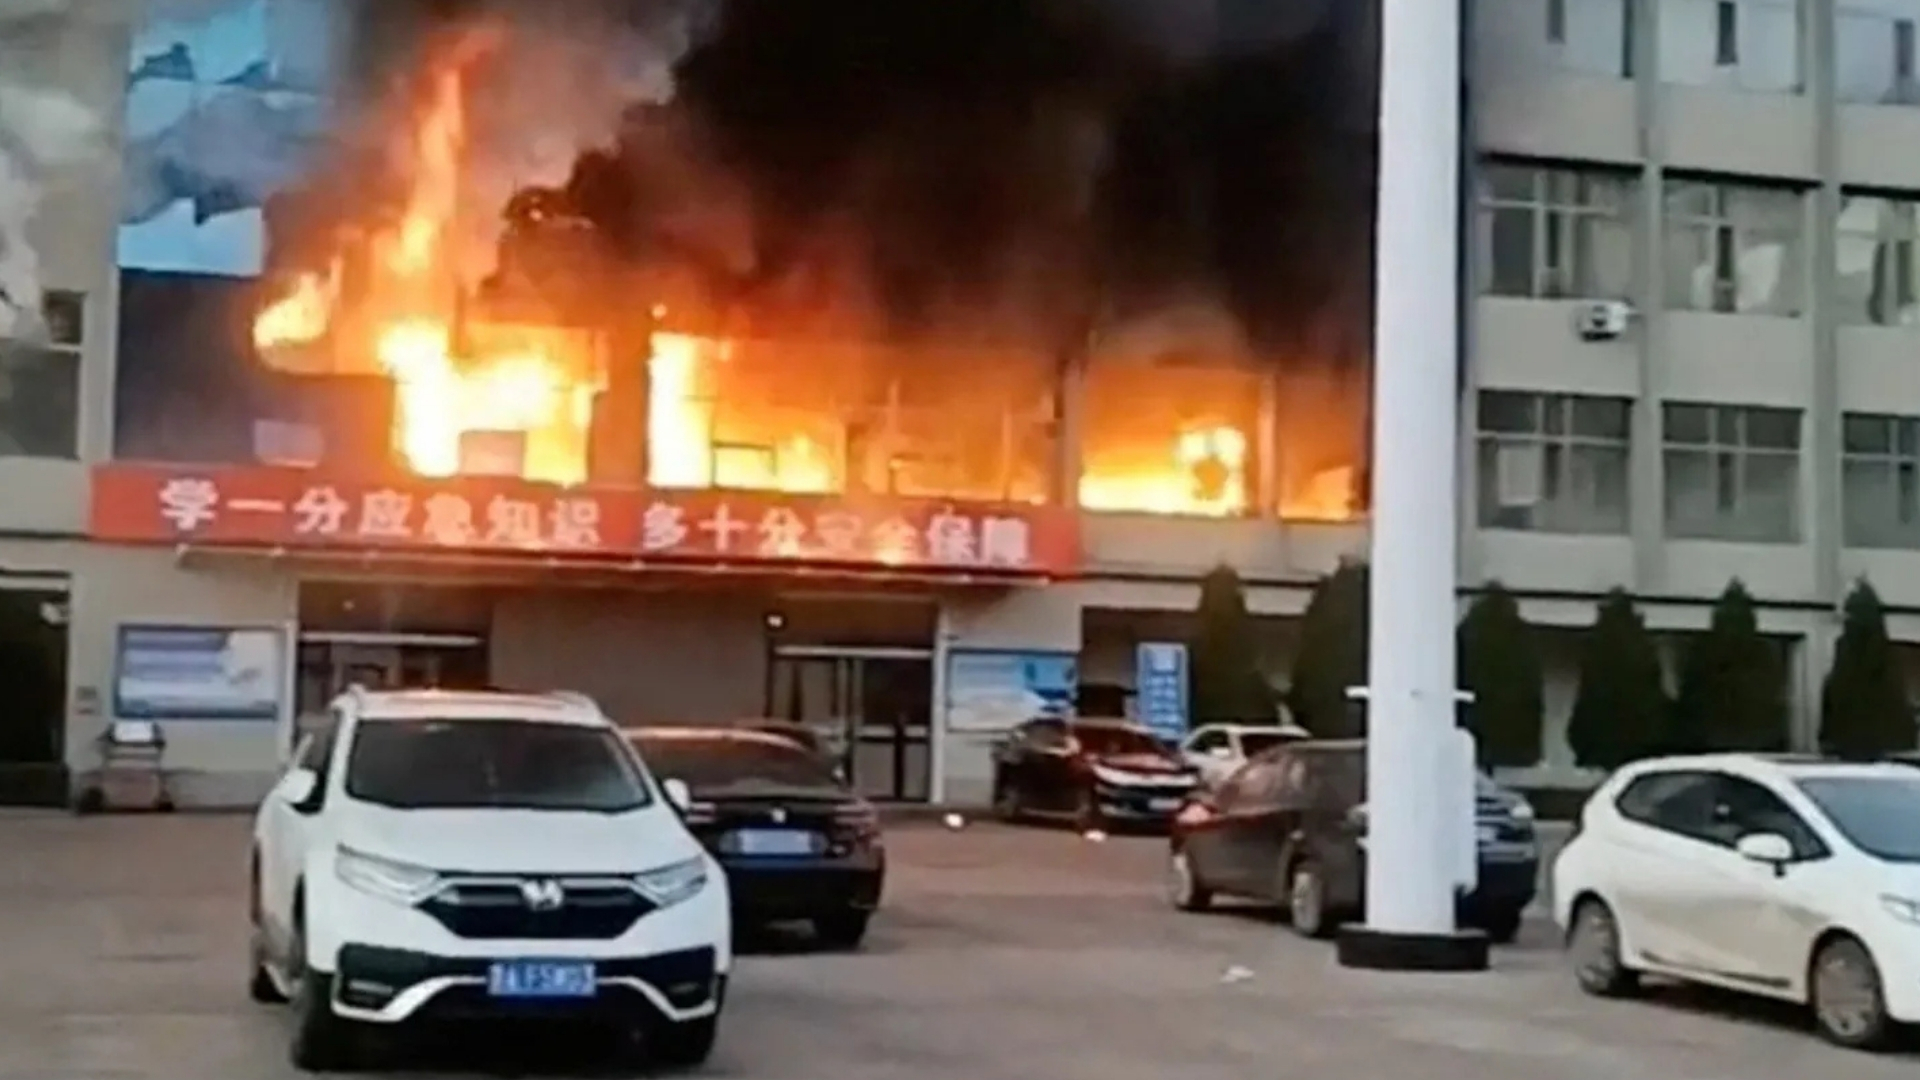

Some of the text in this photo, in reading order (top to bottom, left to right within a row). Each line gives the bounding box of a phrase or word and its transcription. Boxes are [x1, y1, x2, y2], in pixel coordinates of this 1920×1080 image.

[159, 477, 1031, 567] 学一分应急知识 多十分安全保障
